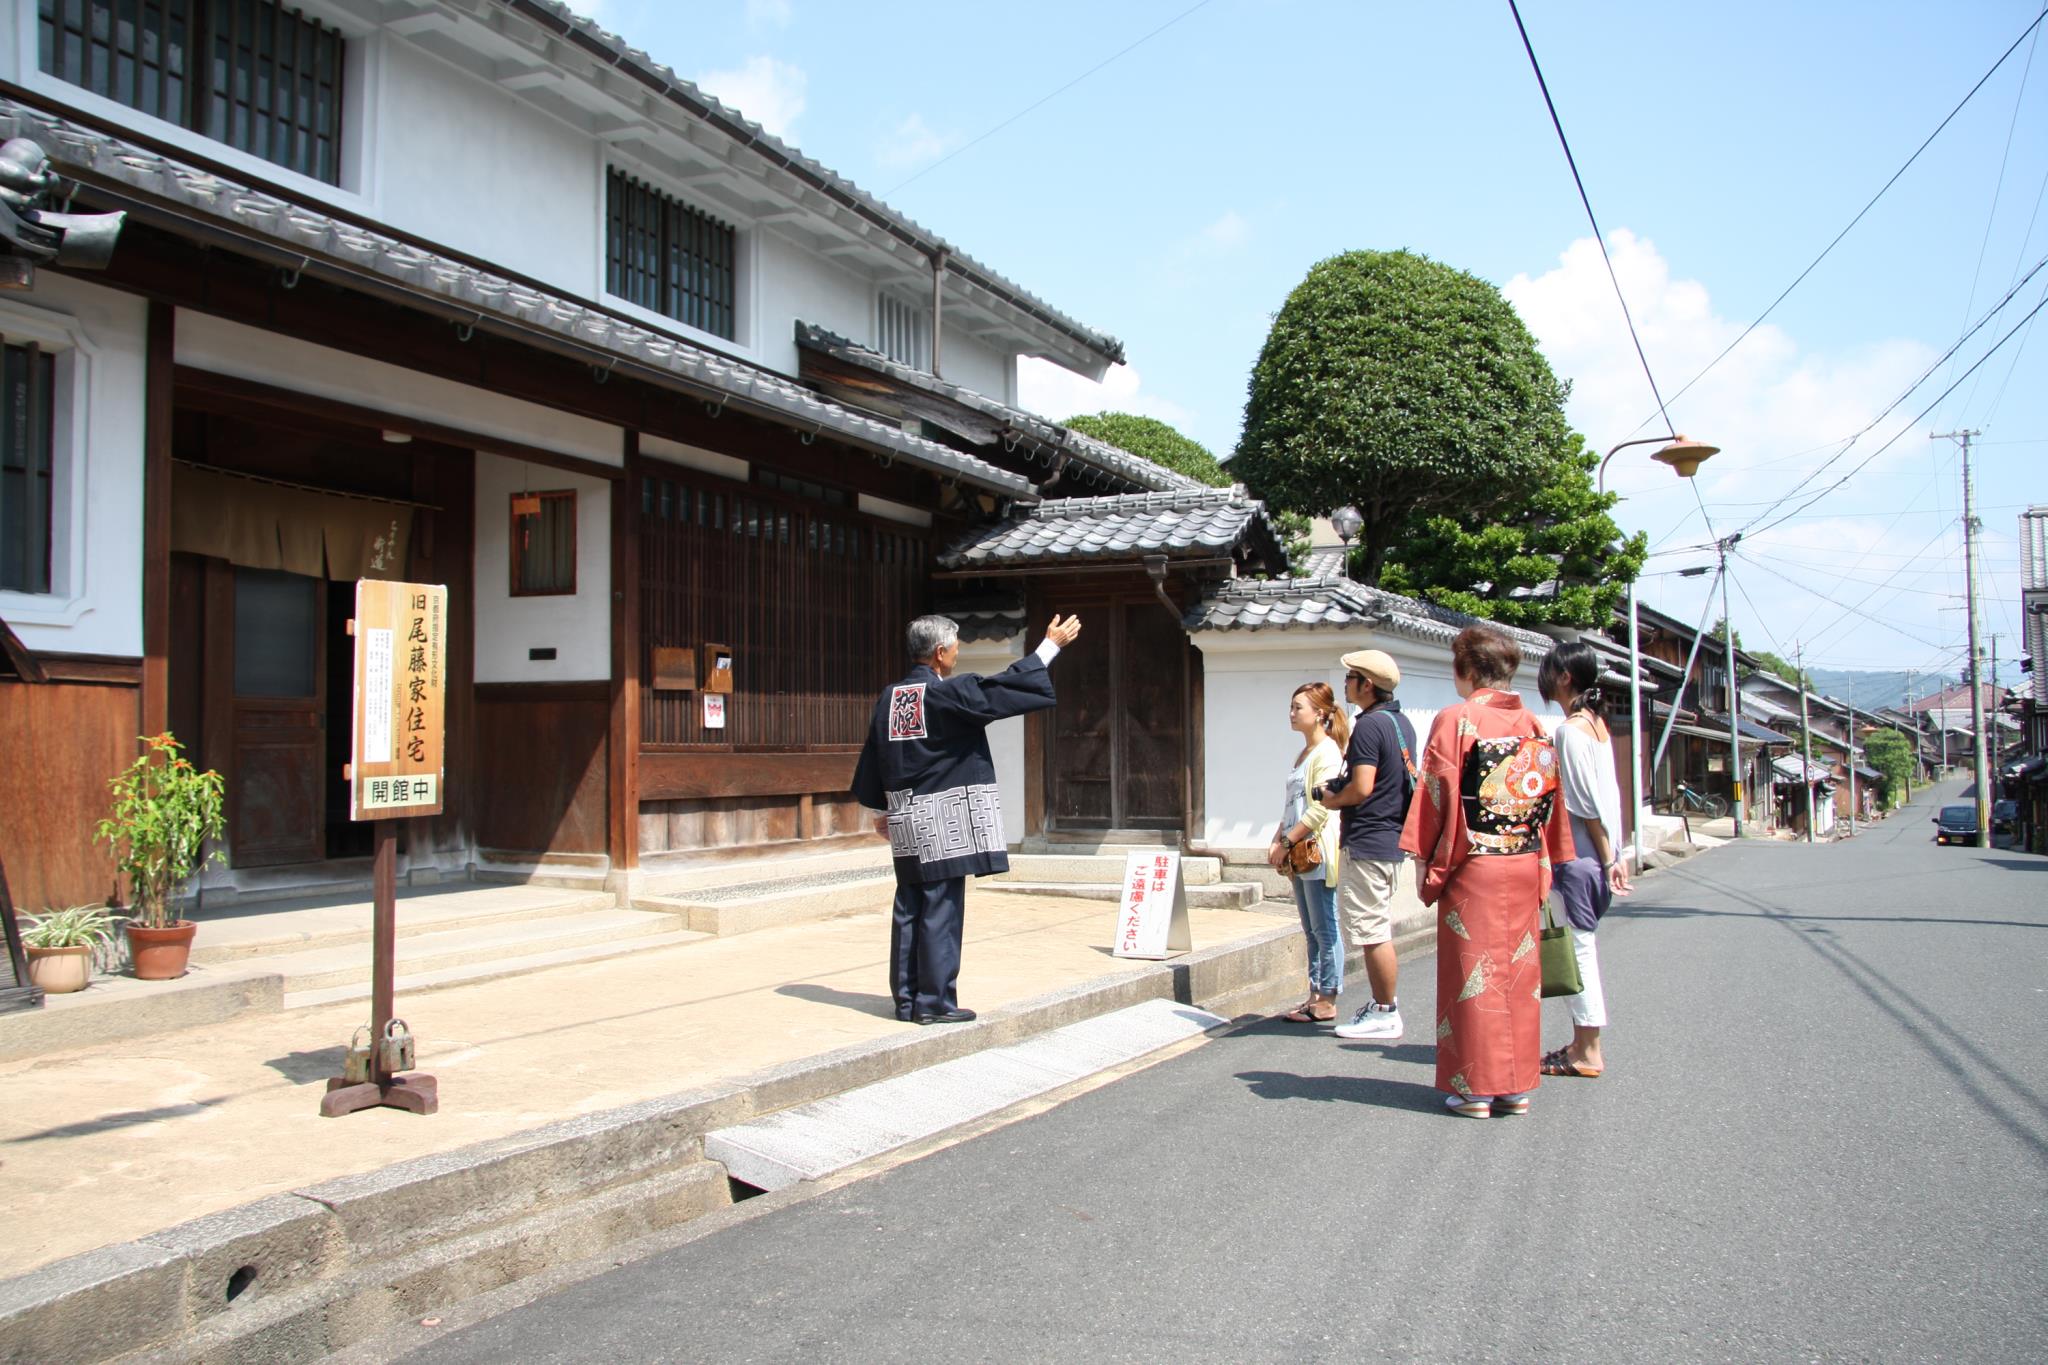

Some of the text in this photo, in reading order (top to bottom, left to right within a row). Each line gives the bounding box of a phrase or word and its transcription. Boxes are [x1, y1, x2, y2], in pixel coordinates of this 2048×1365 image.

[406, 593, 428, 763] 旧尾藤家住宅
[894, 690, 921, 734] 加悦
[372, 779, 429, 803] 開館中
[1151, 855, 1169, 892] 駐車は
[1123, 865, 1148, 951] ご遠慮ください
